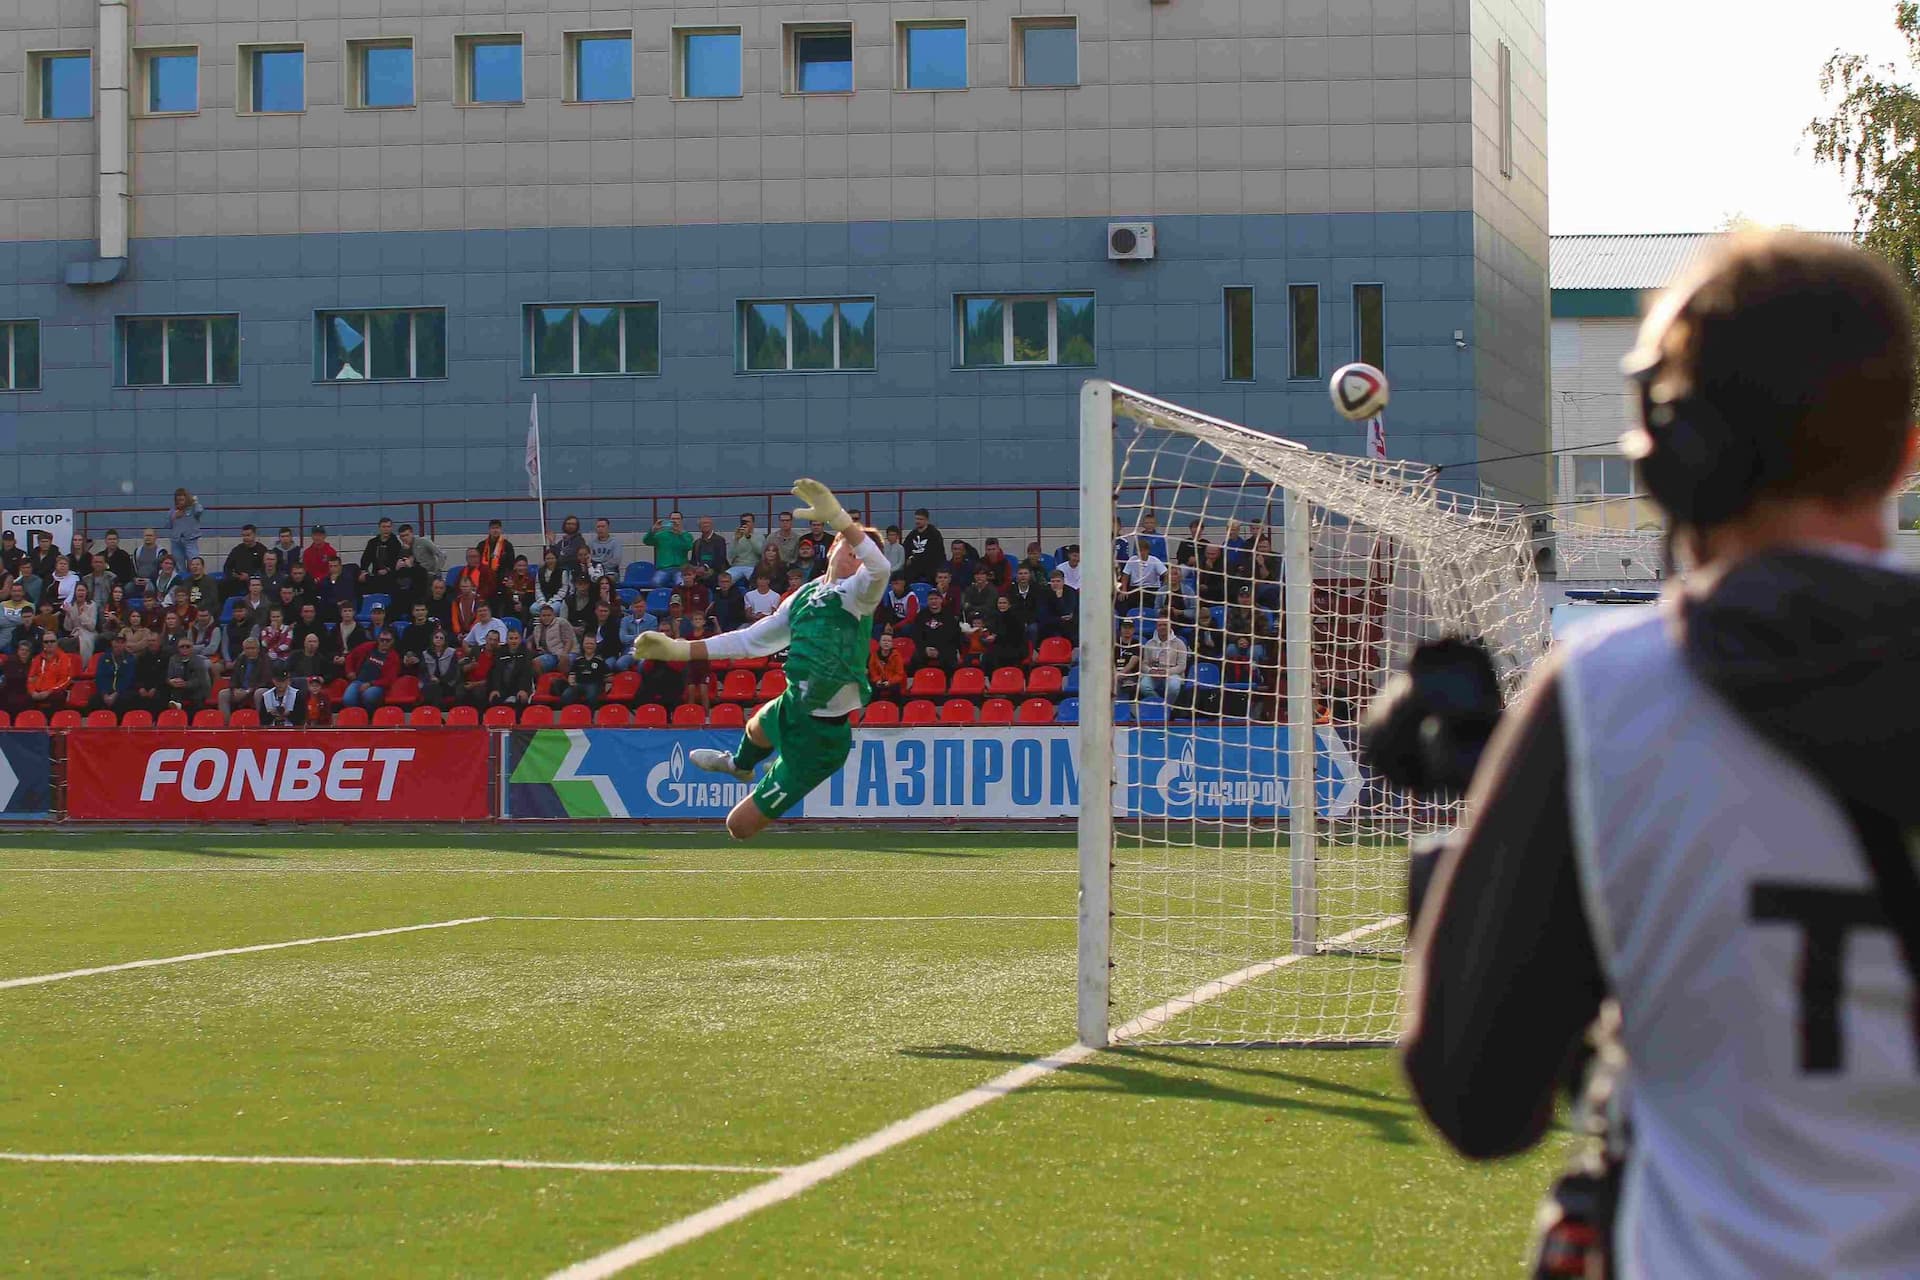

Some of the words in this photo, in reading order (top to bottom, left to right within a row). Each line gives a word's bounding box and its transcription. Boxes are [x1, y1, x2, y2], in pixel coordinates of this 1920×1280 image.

[11, 514, 63, 525] СЕКТОР
[139, 748, 415, 802] FONBET
[687, 783, 757, 807] ГАЗПР
[761, 781, 788, 809] 71
[1198, 781, 1291, 806] ГАЗПРОМ
